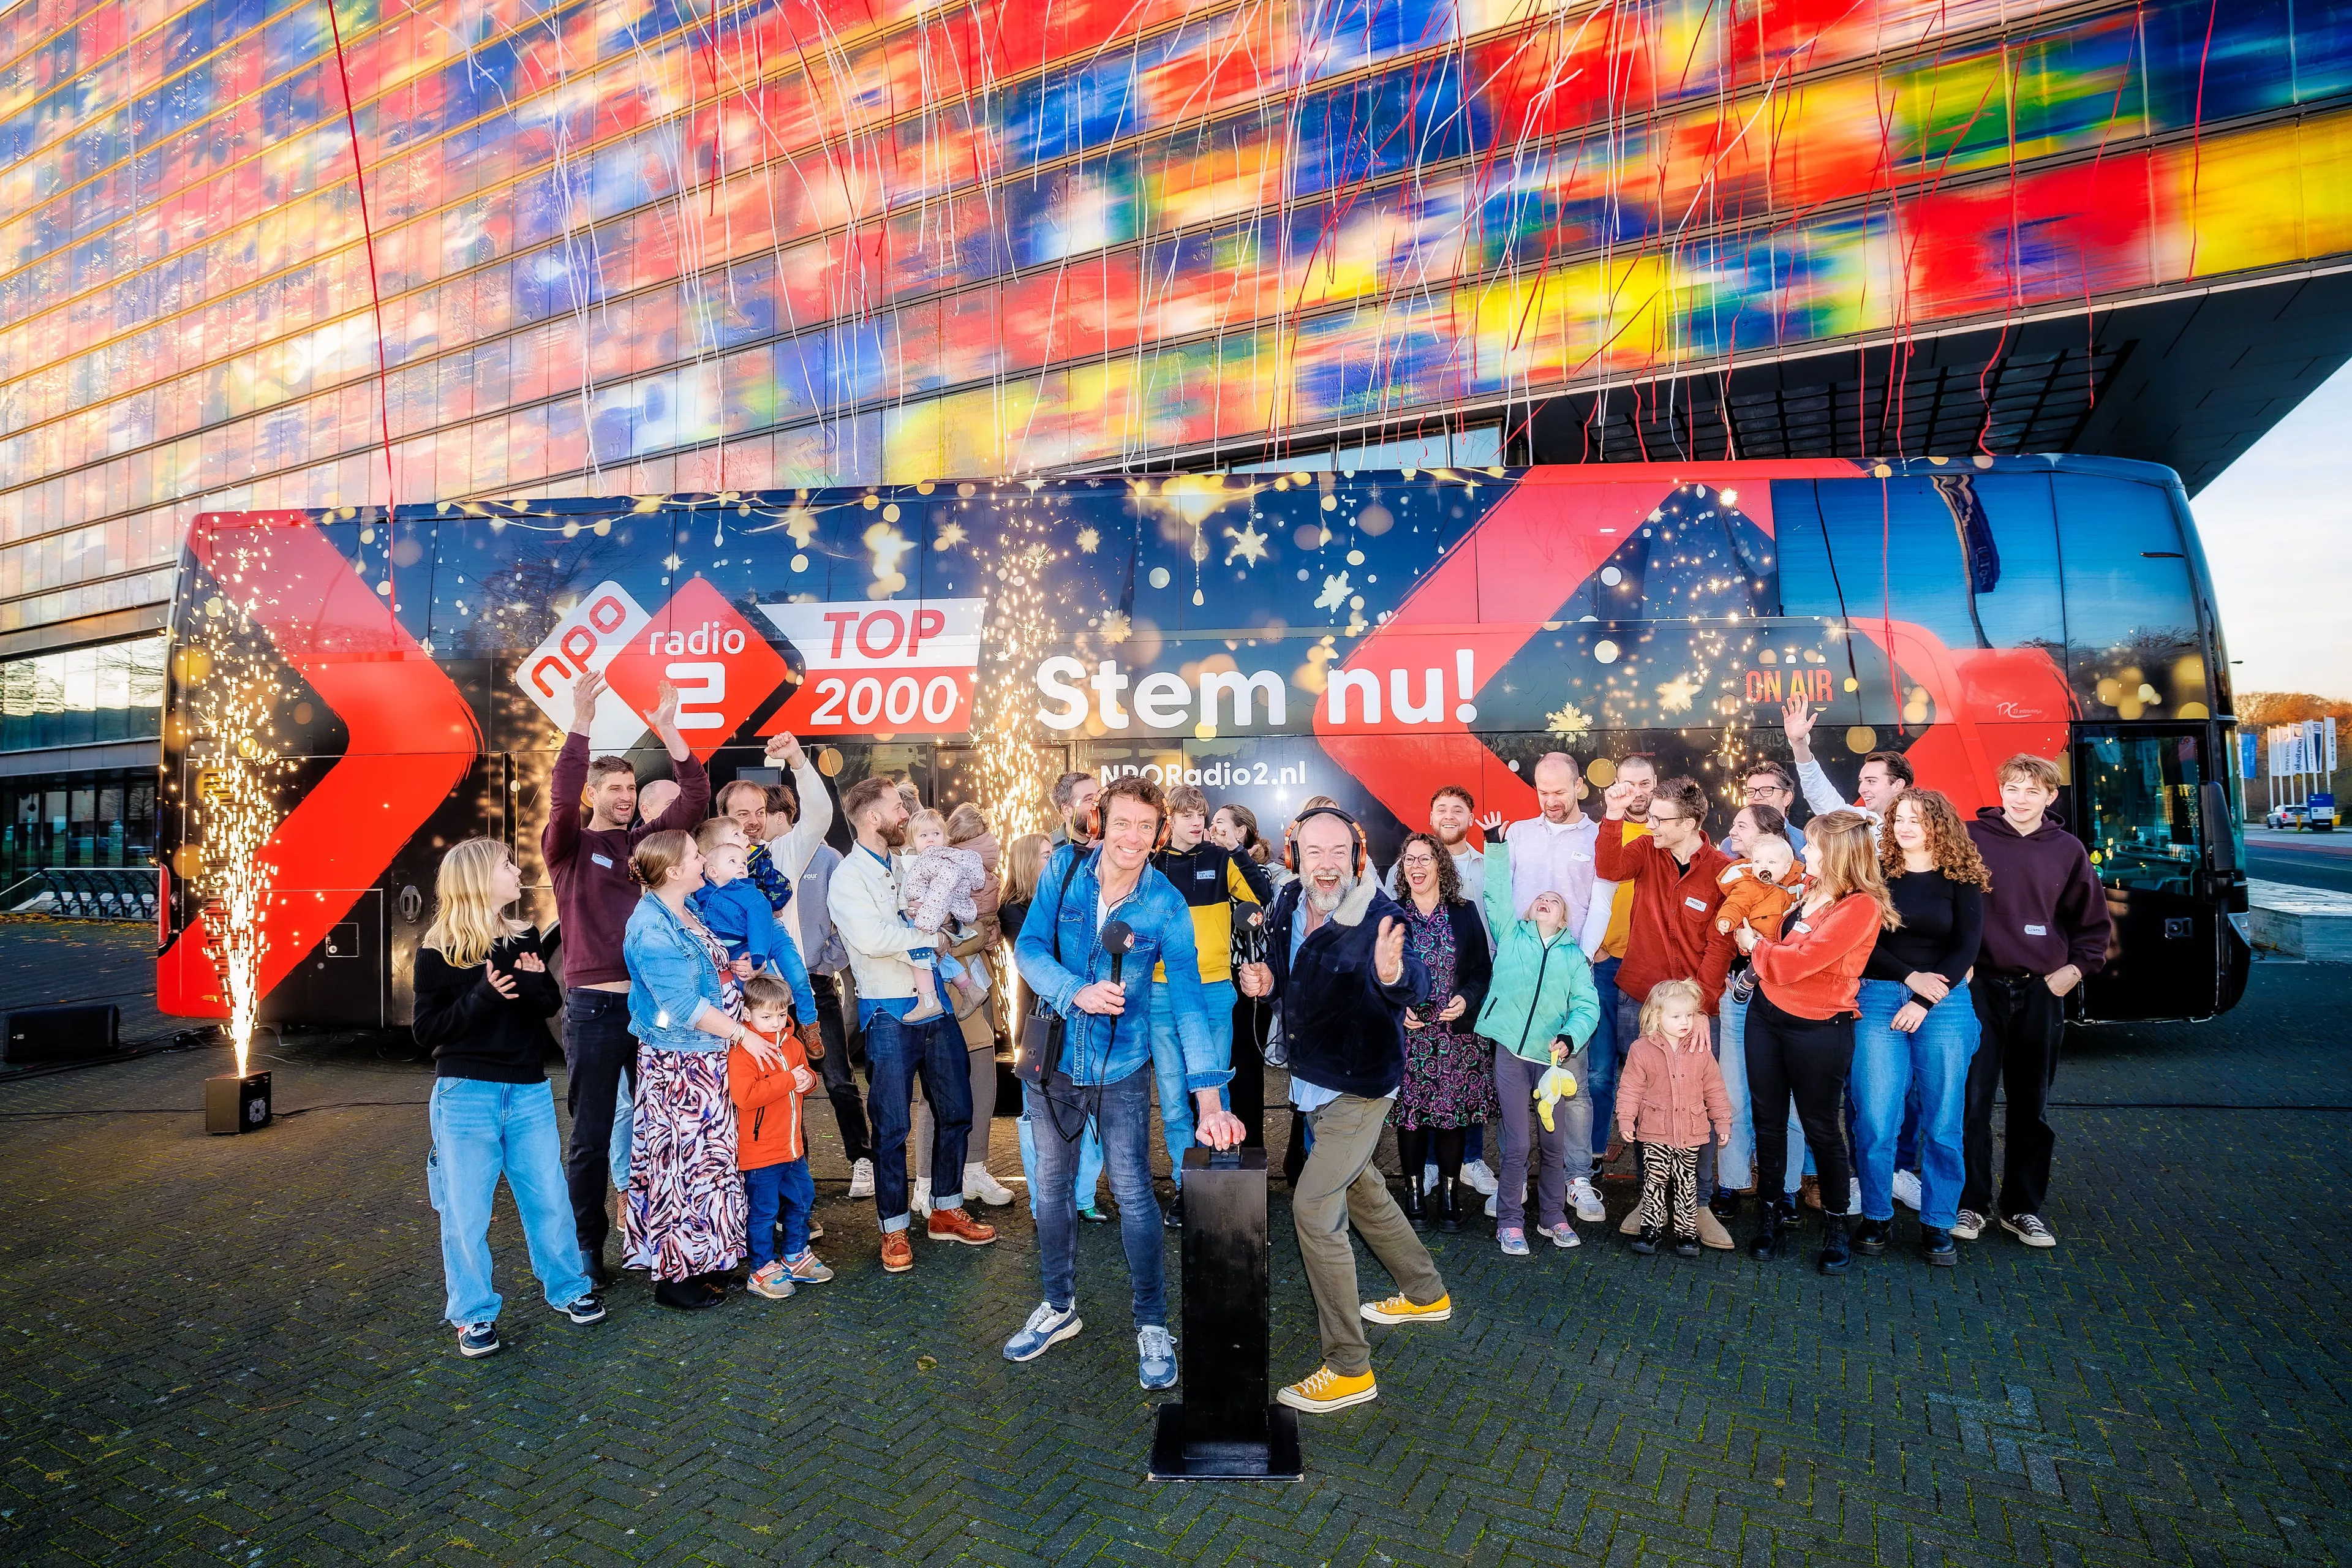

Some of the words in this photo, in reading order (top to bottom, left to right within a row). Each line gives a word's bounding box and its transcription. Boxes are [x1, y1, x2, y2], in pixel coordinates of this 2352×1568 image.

[532, 596, 626, 698] npo
[649, 621, 745, 656] radio
[823, 609, 945, 659] TOP
[665, 662, 725, 729] 2
[810, 676, 957, 725] 2000
[1036, 655, 1286, 730] Stem
[1327, 649, 1477, 725] nu!
[1746, 671, 1781, 703] ON
[1790, 669, 1833, 702] AIR
